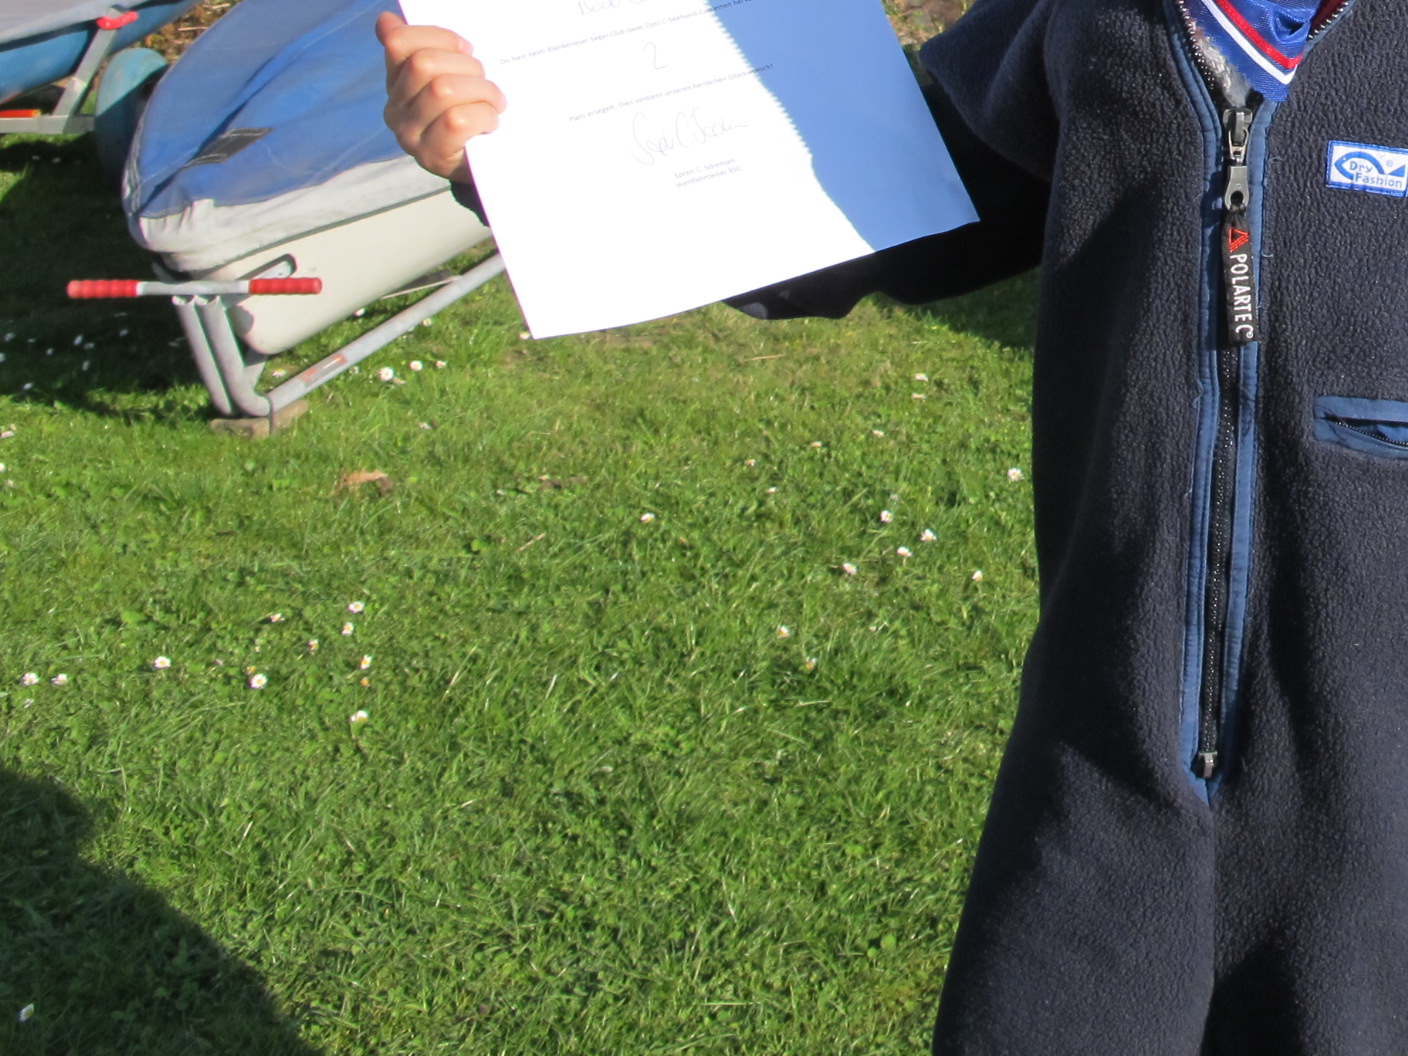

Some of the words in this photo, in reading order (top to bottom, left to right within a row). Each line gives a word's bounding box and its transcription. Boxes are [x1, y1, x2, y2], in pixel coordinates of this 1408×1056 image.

[643, 42, 669, 70] 2
[692, 75, 727, 90] herzlichen
[1349, 160, 1373, 173] Dry
[1355, 172, 1403, 189] Fashion
